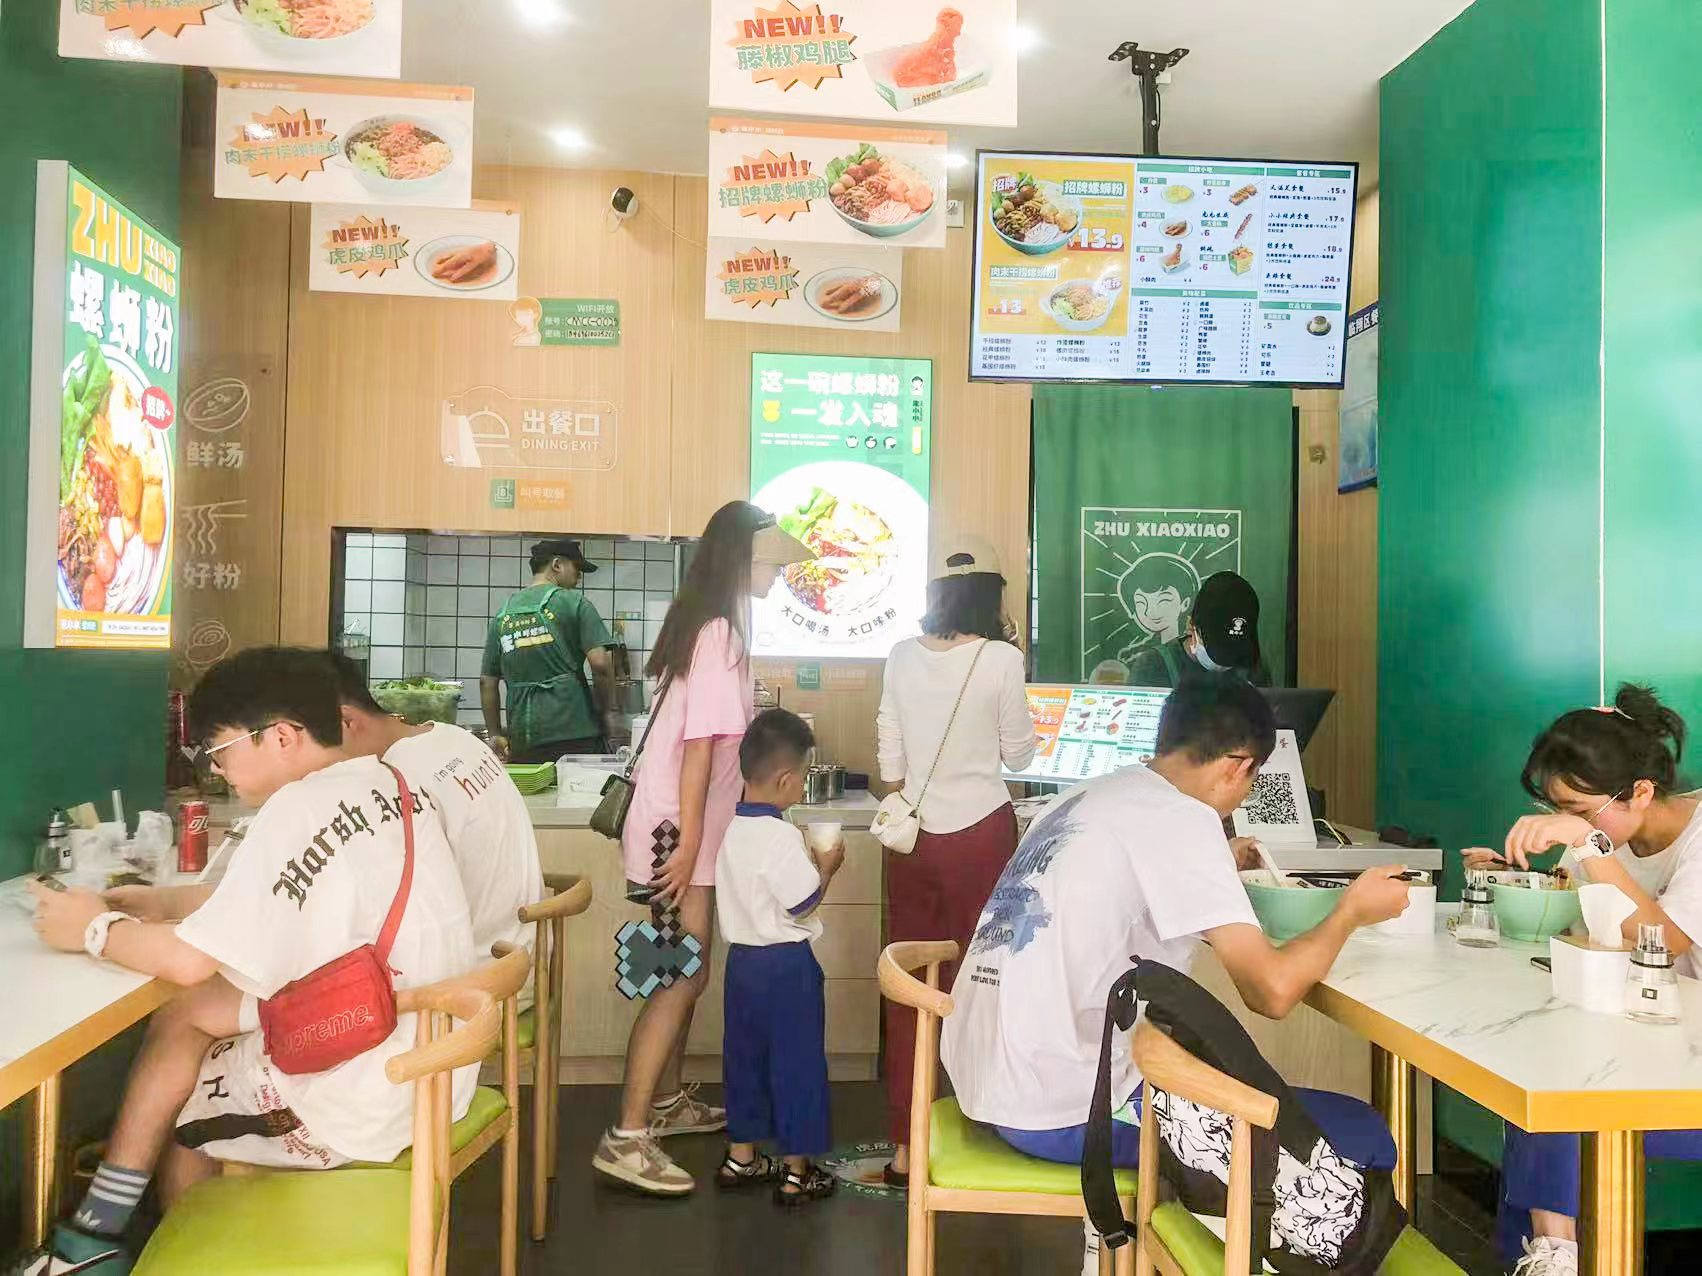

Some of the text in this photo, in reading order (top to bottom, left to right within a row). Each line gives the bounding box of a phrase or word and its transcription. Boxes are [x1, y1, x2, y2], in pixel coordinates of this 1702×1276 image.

[743, 14, 842, 39] NEW!!
[736, 40, 852, 71] 藤椒鸡腿
[733, 160, 811, 181] NEW!!
[719, 178, 829, 208] 招牌螺蛳粉
[72, 181, 143, 275] ZHU
[332, 224, 399, 243] NEW!!
[328, 242, 407, 265] 虎皮鸡爪
[726, 256, 791, 274] NEW!!
[724, 272, 798, 295] 虎皮鸡爪
[521, 408, 600, 437] 出餐口
[186, 441, 244, 469] 鲜汤
[521, 438, 601, 452] DINING EXIT
[1094, 521, 1231, 538] ZHU XIAOXIAO
[183, 562, 242, 590] 好粉
